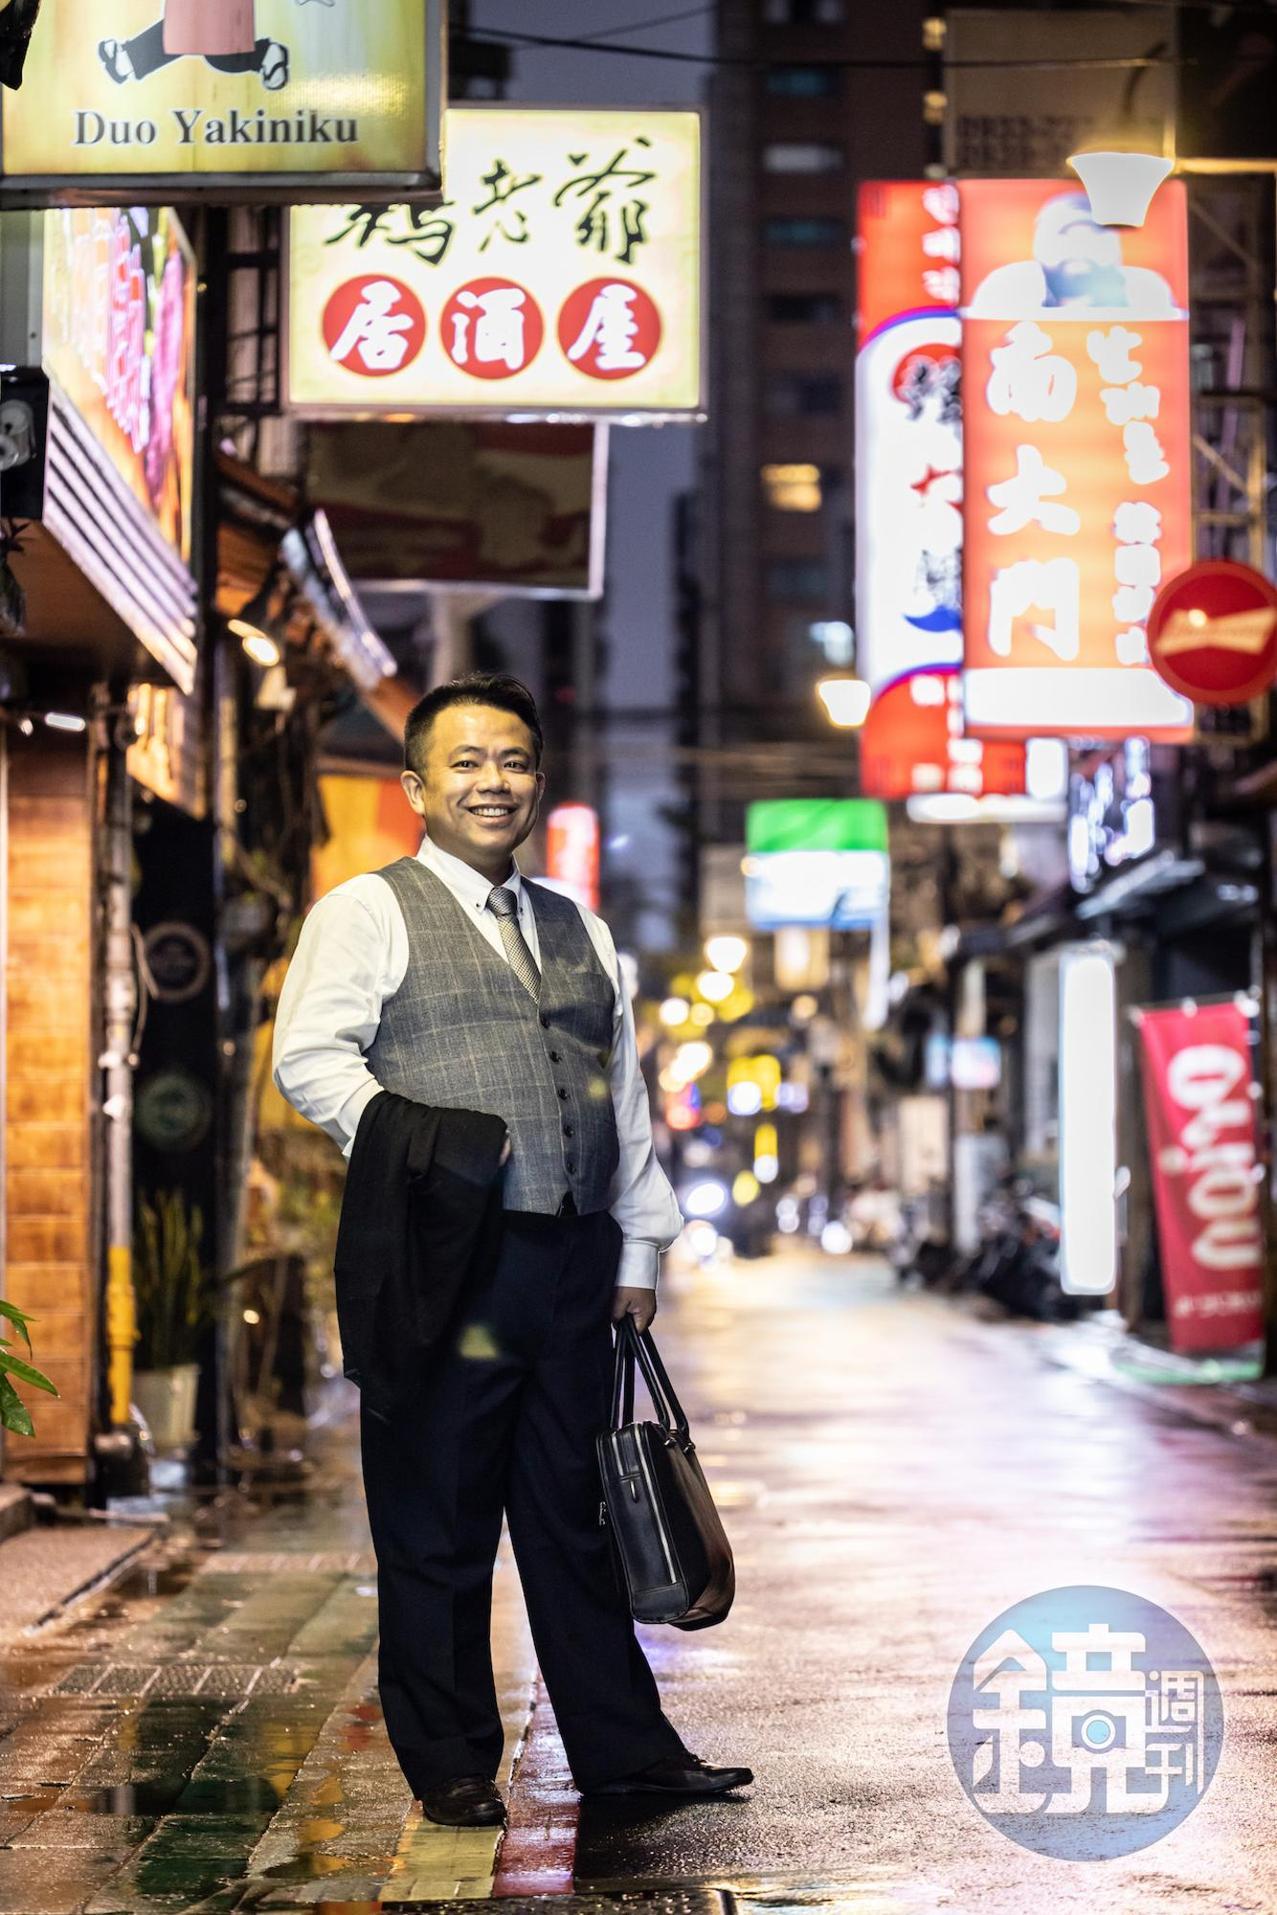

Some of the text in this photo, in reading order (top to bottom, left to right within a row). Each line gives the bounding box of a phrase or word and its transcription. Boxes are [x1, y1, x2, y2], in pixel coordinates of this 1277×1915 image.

[75, 109, 359, 145] Duo Yakiniku
[330, 280, 646, 371] 居酒屋
